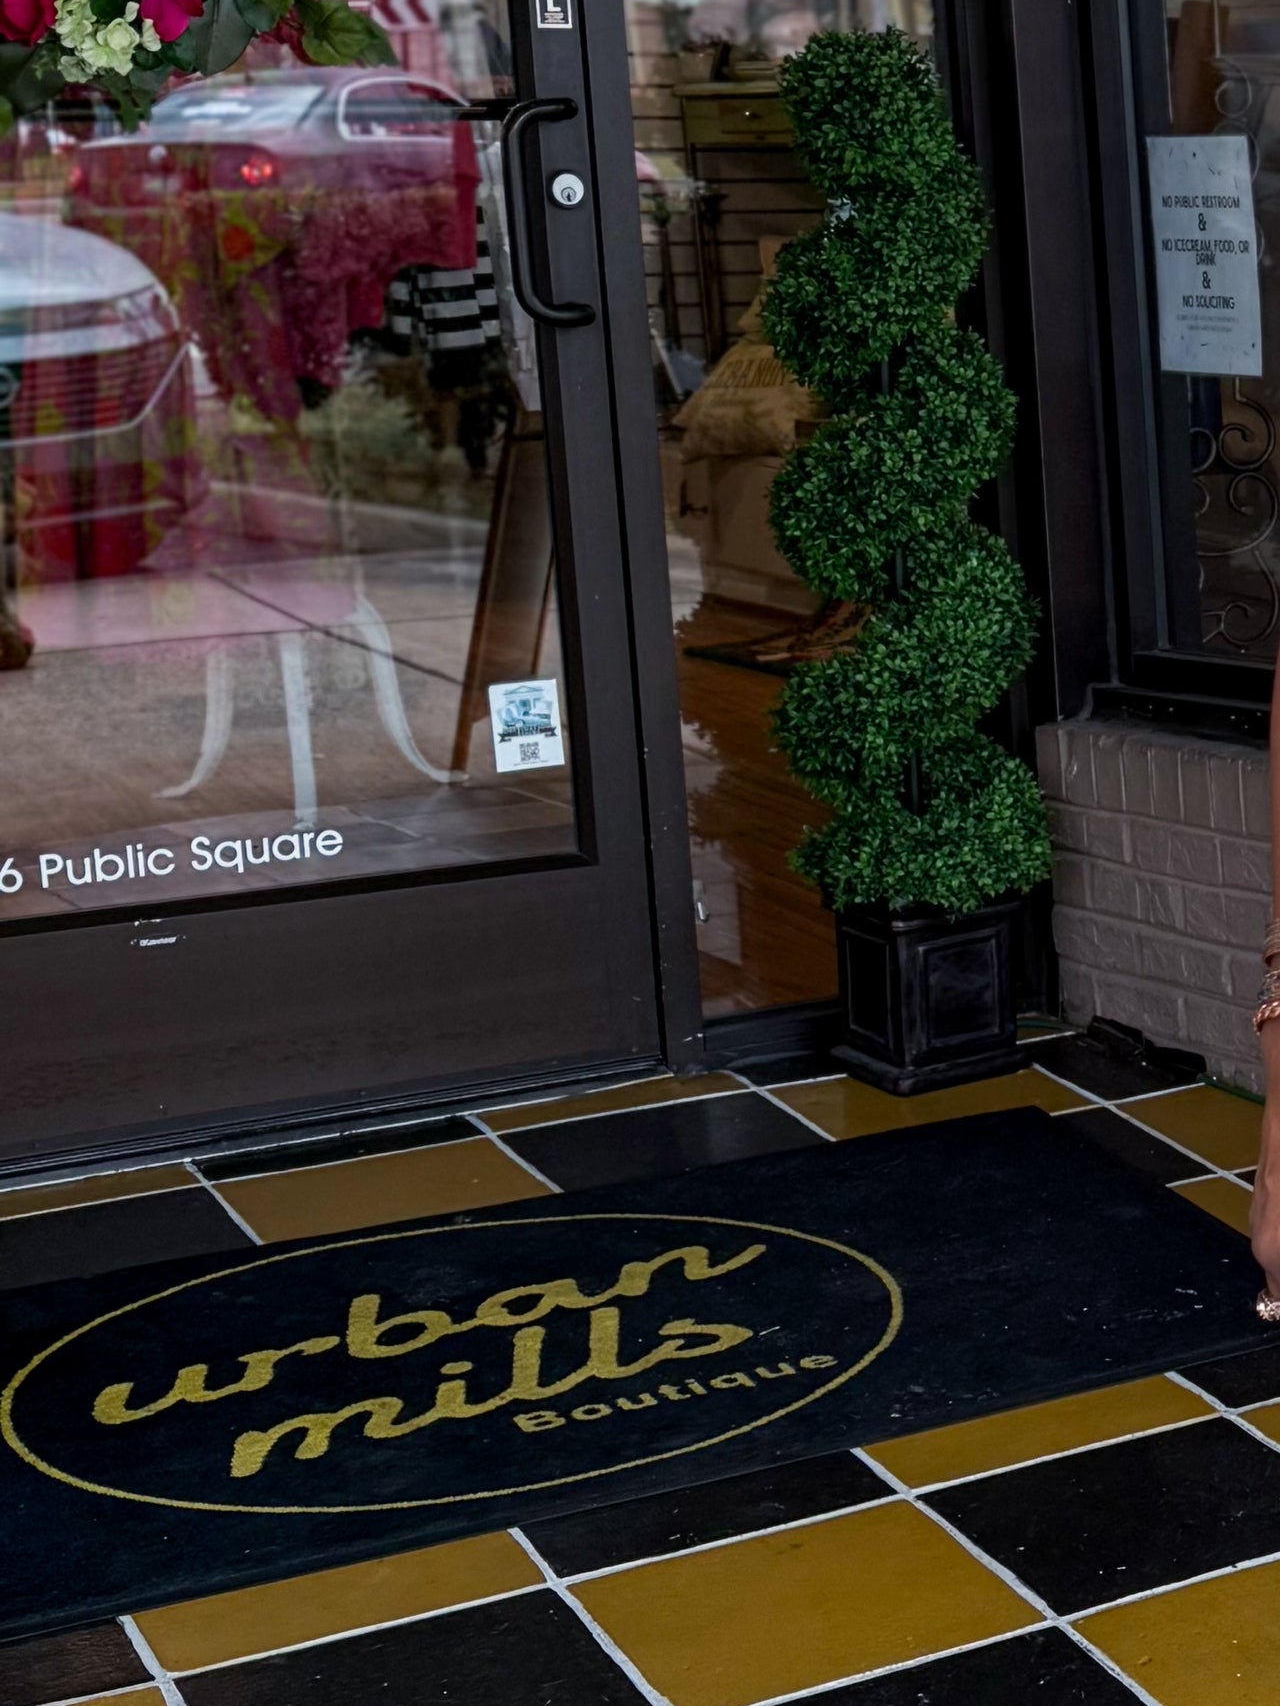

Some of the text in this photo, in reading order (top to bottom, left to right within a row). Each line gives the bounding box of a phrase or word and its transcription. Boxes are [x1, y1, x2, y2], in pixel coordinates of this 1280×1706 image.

[1162, 195, 1240, 209] NO PUBLIC RESTROOM
[1198, 213, 1207, 231] &
[1162, 239, 1173, 252] NO
[1239, 240, 1250, 254] OR
[1195, 252, 1216, 266] DRINK
[1202, 271, 1211, 289] &
[1182, 295, 1235, 310] NO SOLICITING
[39, 843, 176, 890] Public
[190, 829, 344, 874] Square
[512, 1354, 839, 1434] Boutique
